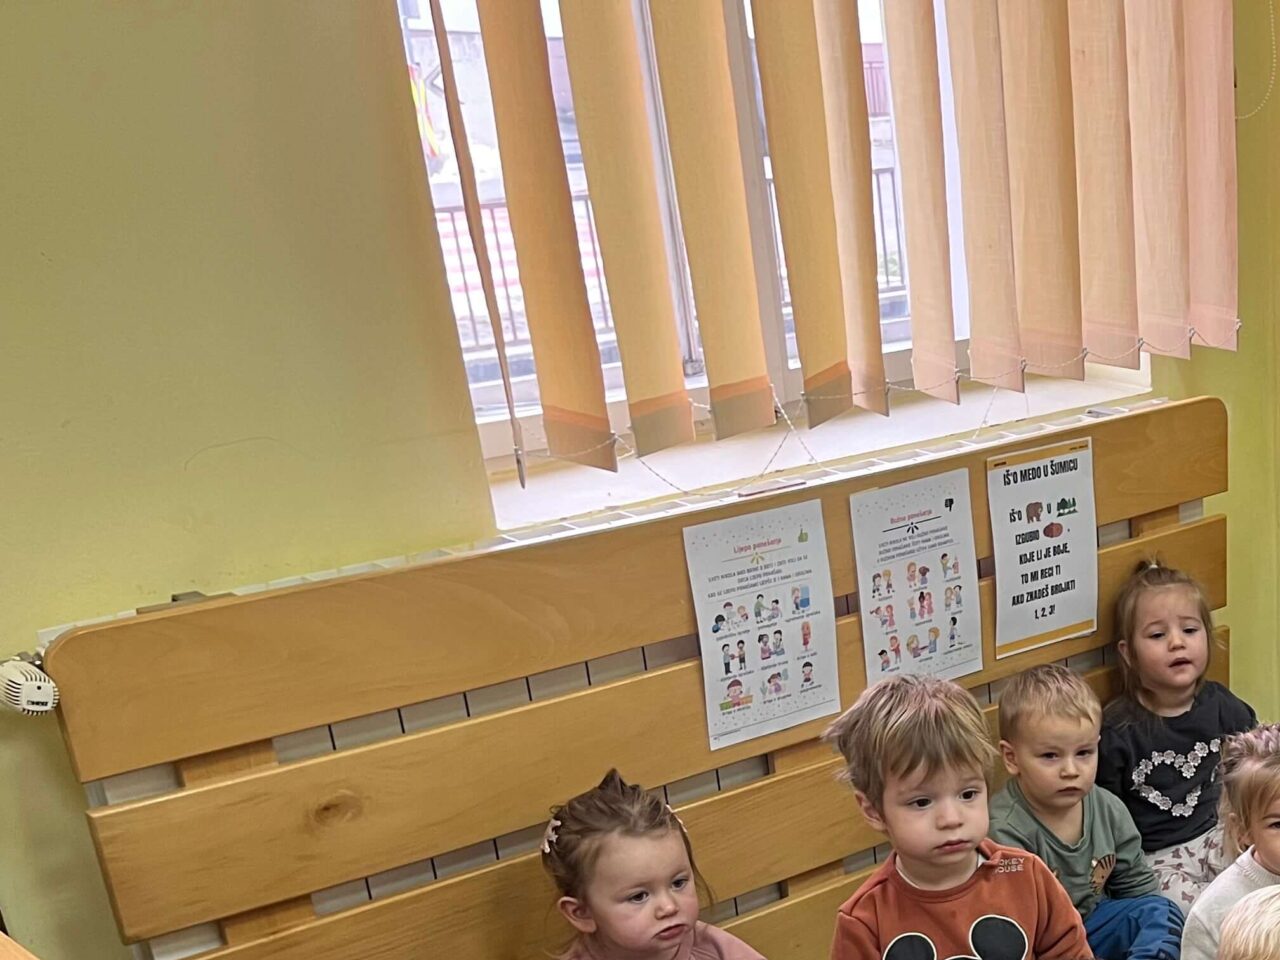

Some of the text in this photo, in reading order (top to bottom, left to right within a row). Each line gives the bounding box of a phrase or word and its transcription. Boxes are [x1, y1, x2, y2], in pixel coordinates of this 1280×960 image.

[1020, 466, 1042, 483] MEDO
[1043, 464, 1049, 477] U
[1050, 458, 1078, 476] ŠUMICU
[1046, 503, 1052, 514] U
[1015, 529, 1040, 545] IZGUBIO
[1019, 551, 1035, 565] KOJE
[1036, 549, 1043, 561] LI
[1043, 547, 1051, 559] JE
[1021, 564, 1061, 585] TO MI RECI TI
[1011, 579, 1076, 607] AKO ZNADEŠ BROJATI
